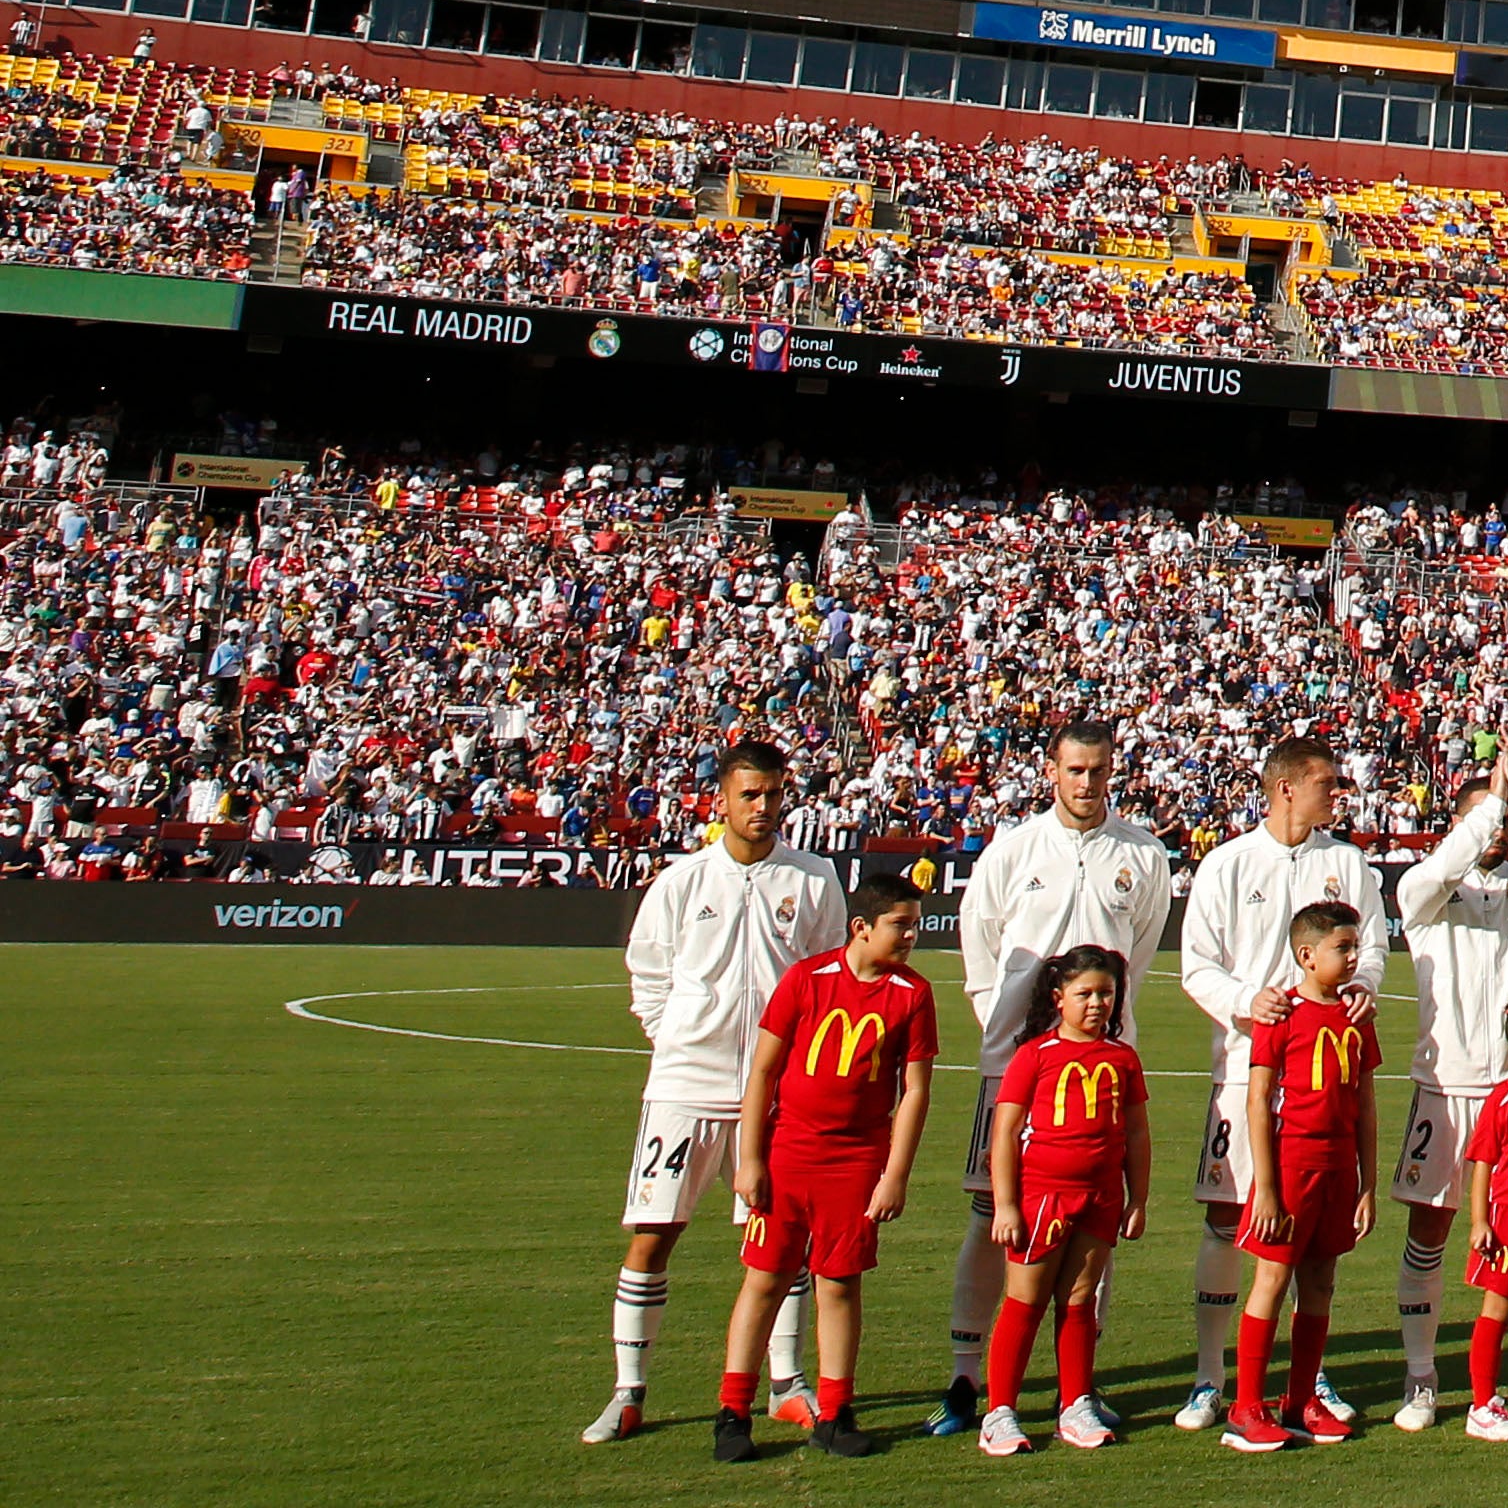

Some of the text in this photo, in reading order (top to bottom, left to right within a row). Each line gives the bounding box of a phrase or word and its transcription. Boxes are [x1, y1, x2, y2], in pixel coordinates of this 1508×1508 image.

[1072, 18, 1217, 55] Merrill Lynch
[328, 137, 355, 152] 321
[329, 302, 533, 344] REAL MADRID
[826, 355, 859, 373] Cup
[880, 363, 943, 378] Heineken
[1109, 363, 1241, 395] JUVENTUS
[215, 899, 343, 929] verizon
[1211, 1118, 1232, 1160] 8
[643, 1136, 693, 1180] 24
